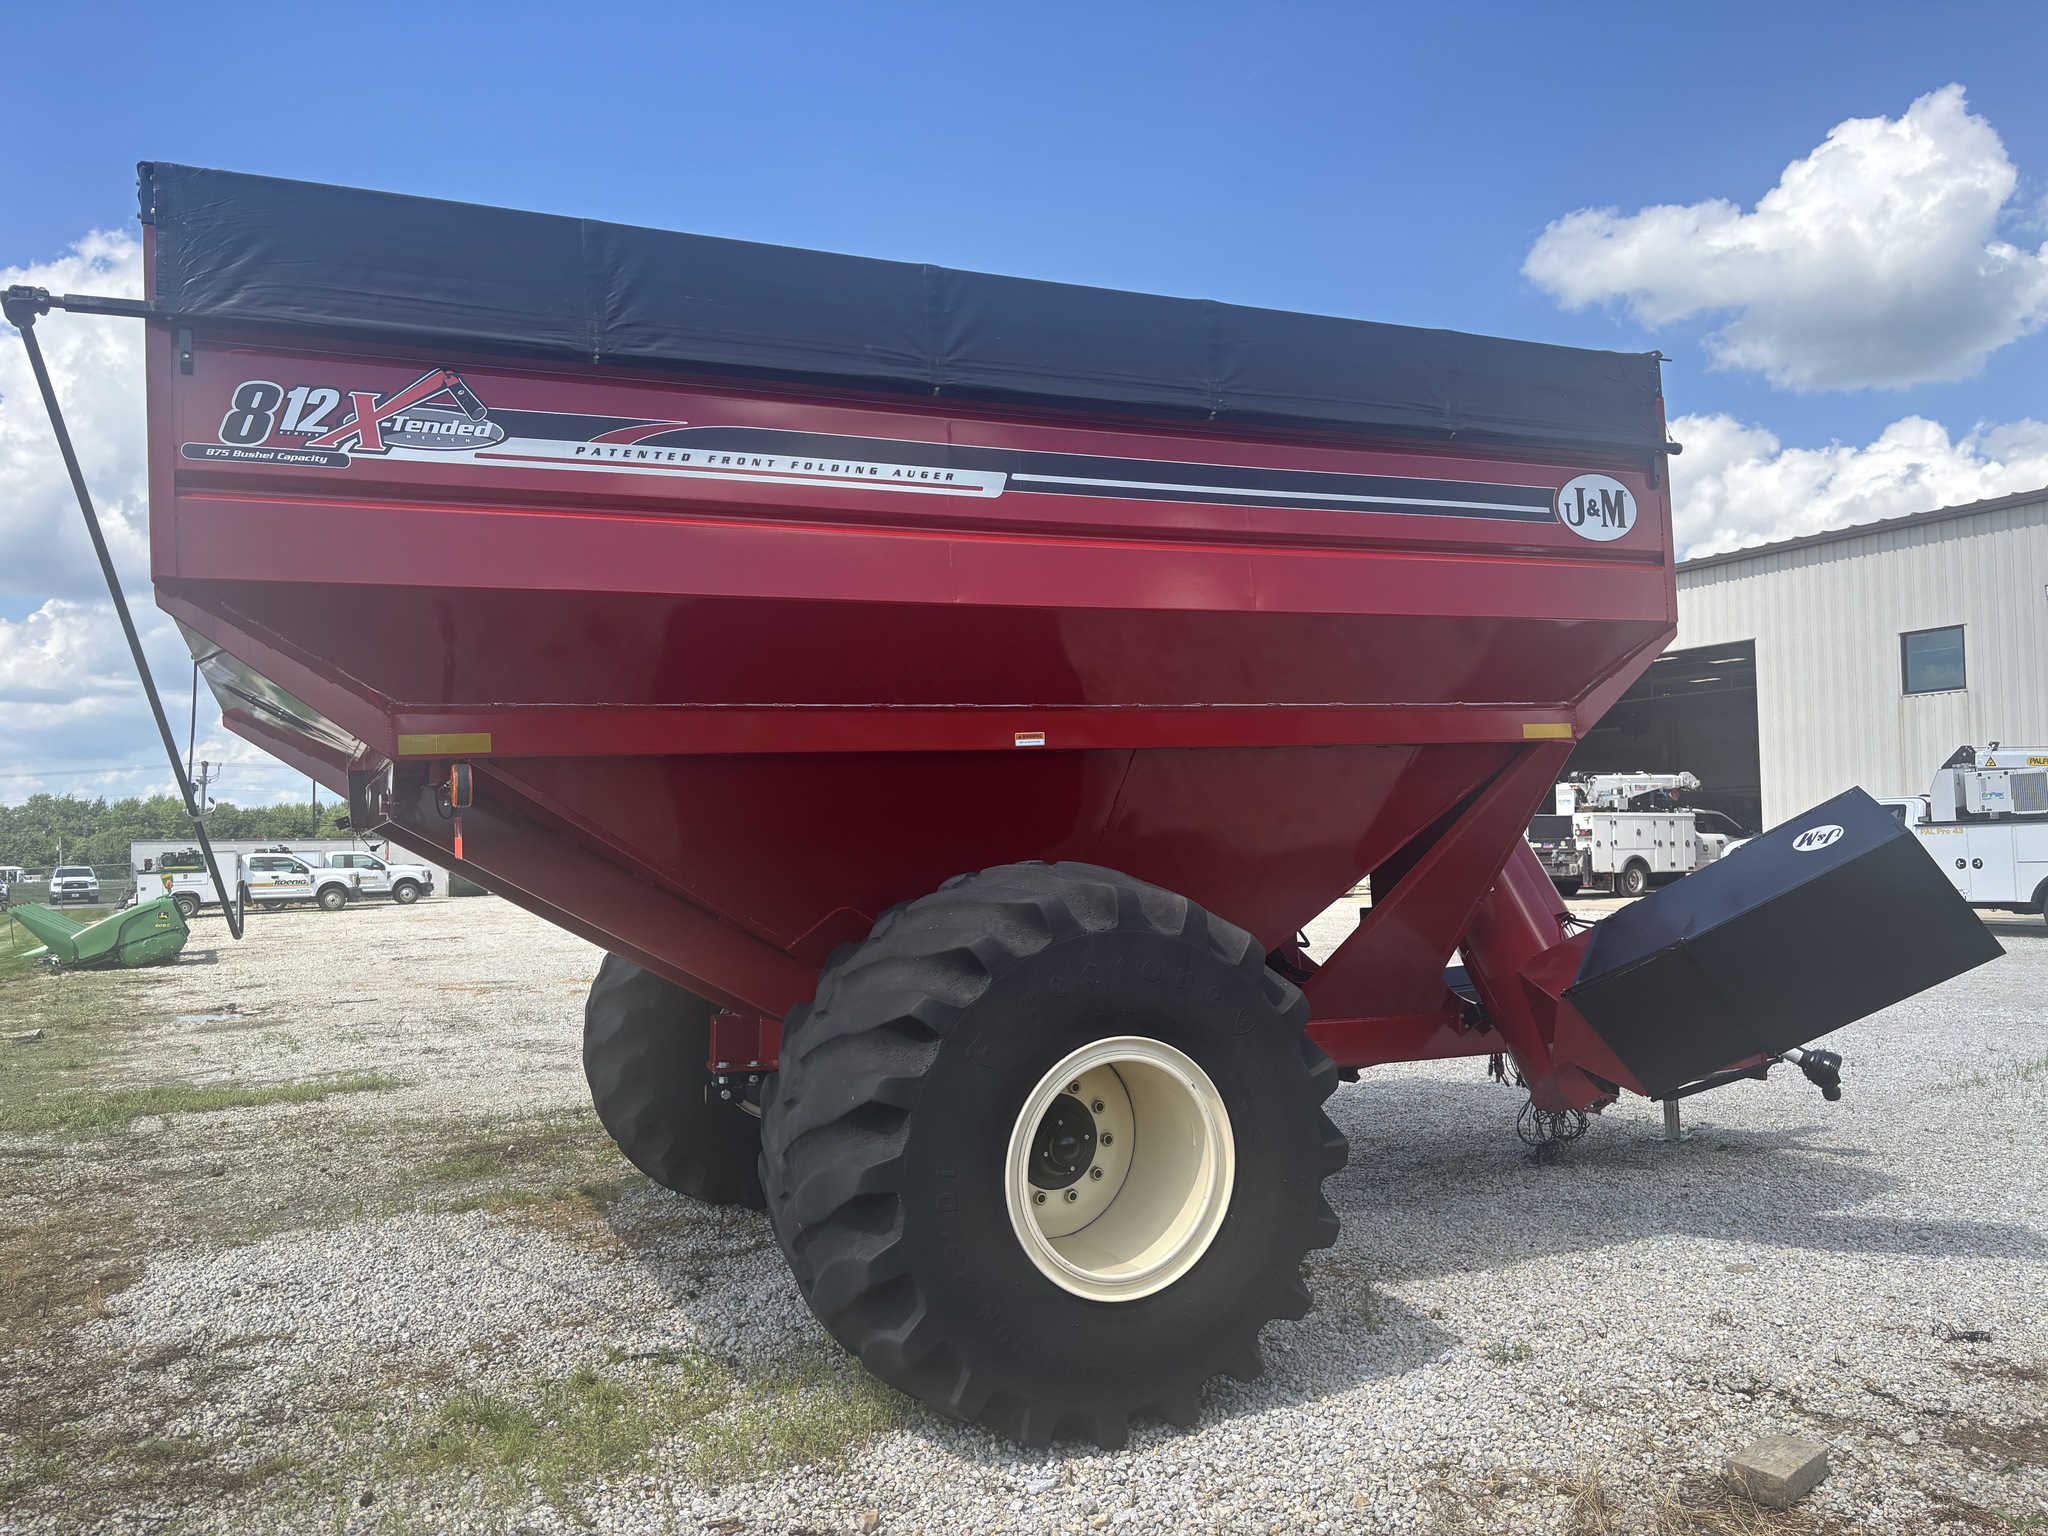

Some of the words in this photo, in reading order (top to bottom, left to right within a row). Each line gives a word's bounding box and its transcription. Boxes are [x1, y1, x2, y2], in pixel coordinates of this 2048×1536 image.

[218, 380, 340, 446] 812
[406, 434, 471, 443] REACH
[206, 448, 230, 457] 875
[233, 450, 274, 459] Bushel
[277, 452, 328, 464] Capacity
[575, 446, 692, 462] PATENTED
[708, 454, 776, 468] FRONT
[791, 460, 879, 476] FOLDING
[892, 468, 955, 481] AUGER
[1563, 487, 1627, 529] J&M
[1796, 828, 1842, 848] J&M
